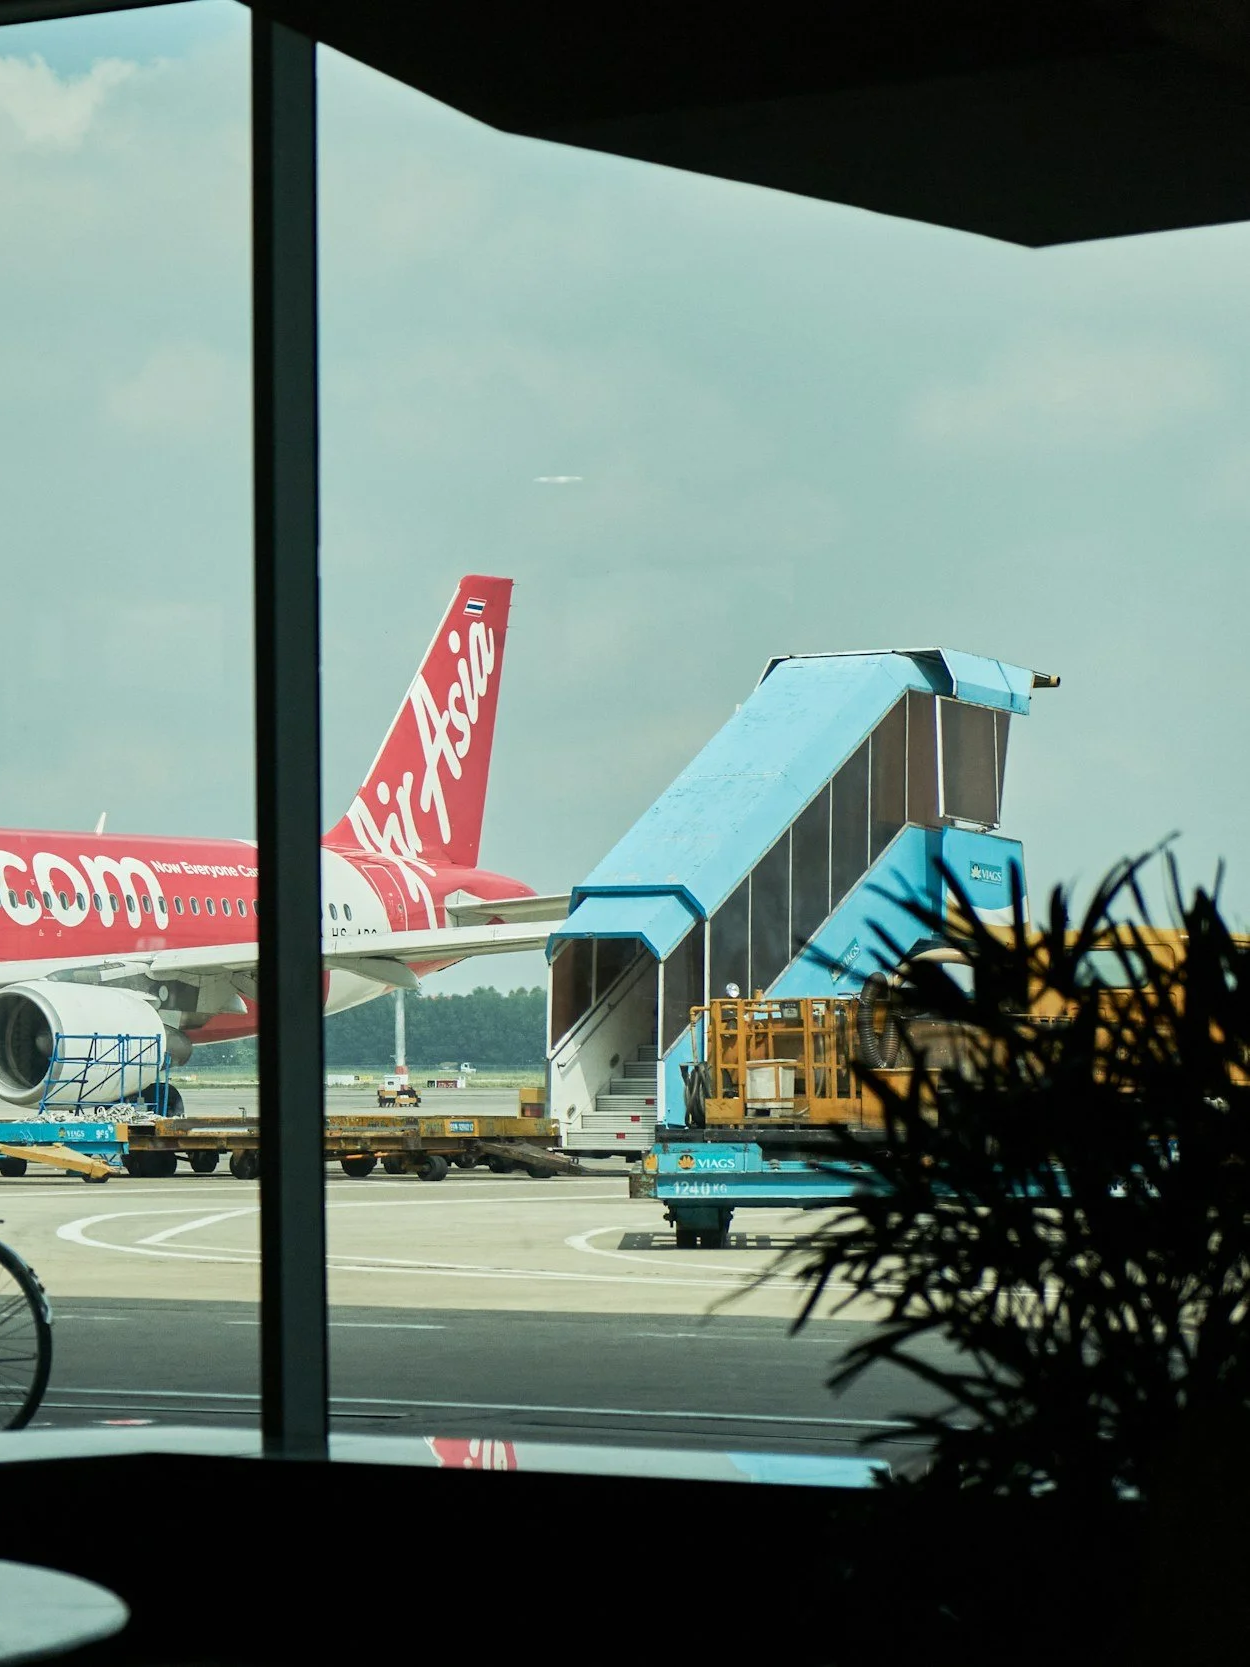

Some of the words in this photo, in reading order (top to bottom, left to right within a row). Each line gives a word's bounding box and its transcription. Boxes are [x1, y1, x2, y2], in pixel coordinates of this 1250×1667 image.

[150, 860, 182, 874] Now
[180, 861, 239, 878] Everyone
[698, 1158, 735, 1168] VIAGS
[673, 1181, 710, 1196] 1240
[713, 1183, 728, 1194] KG
